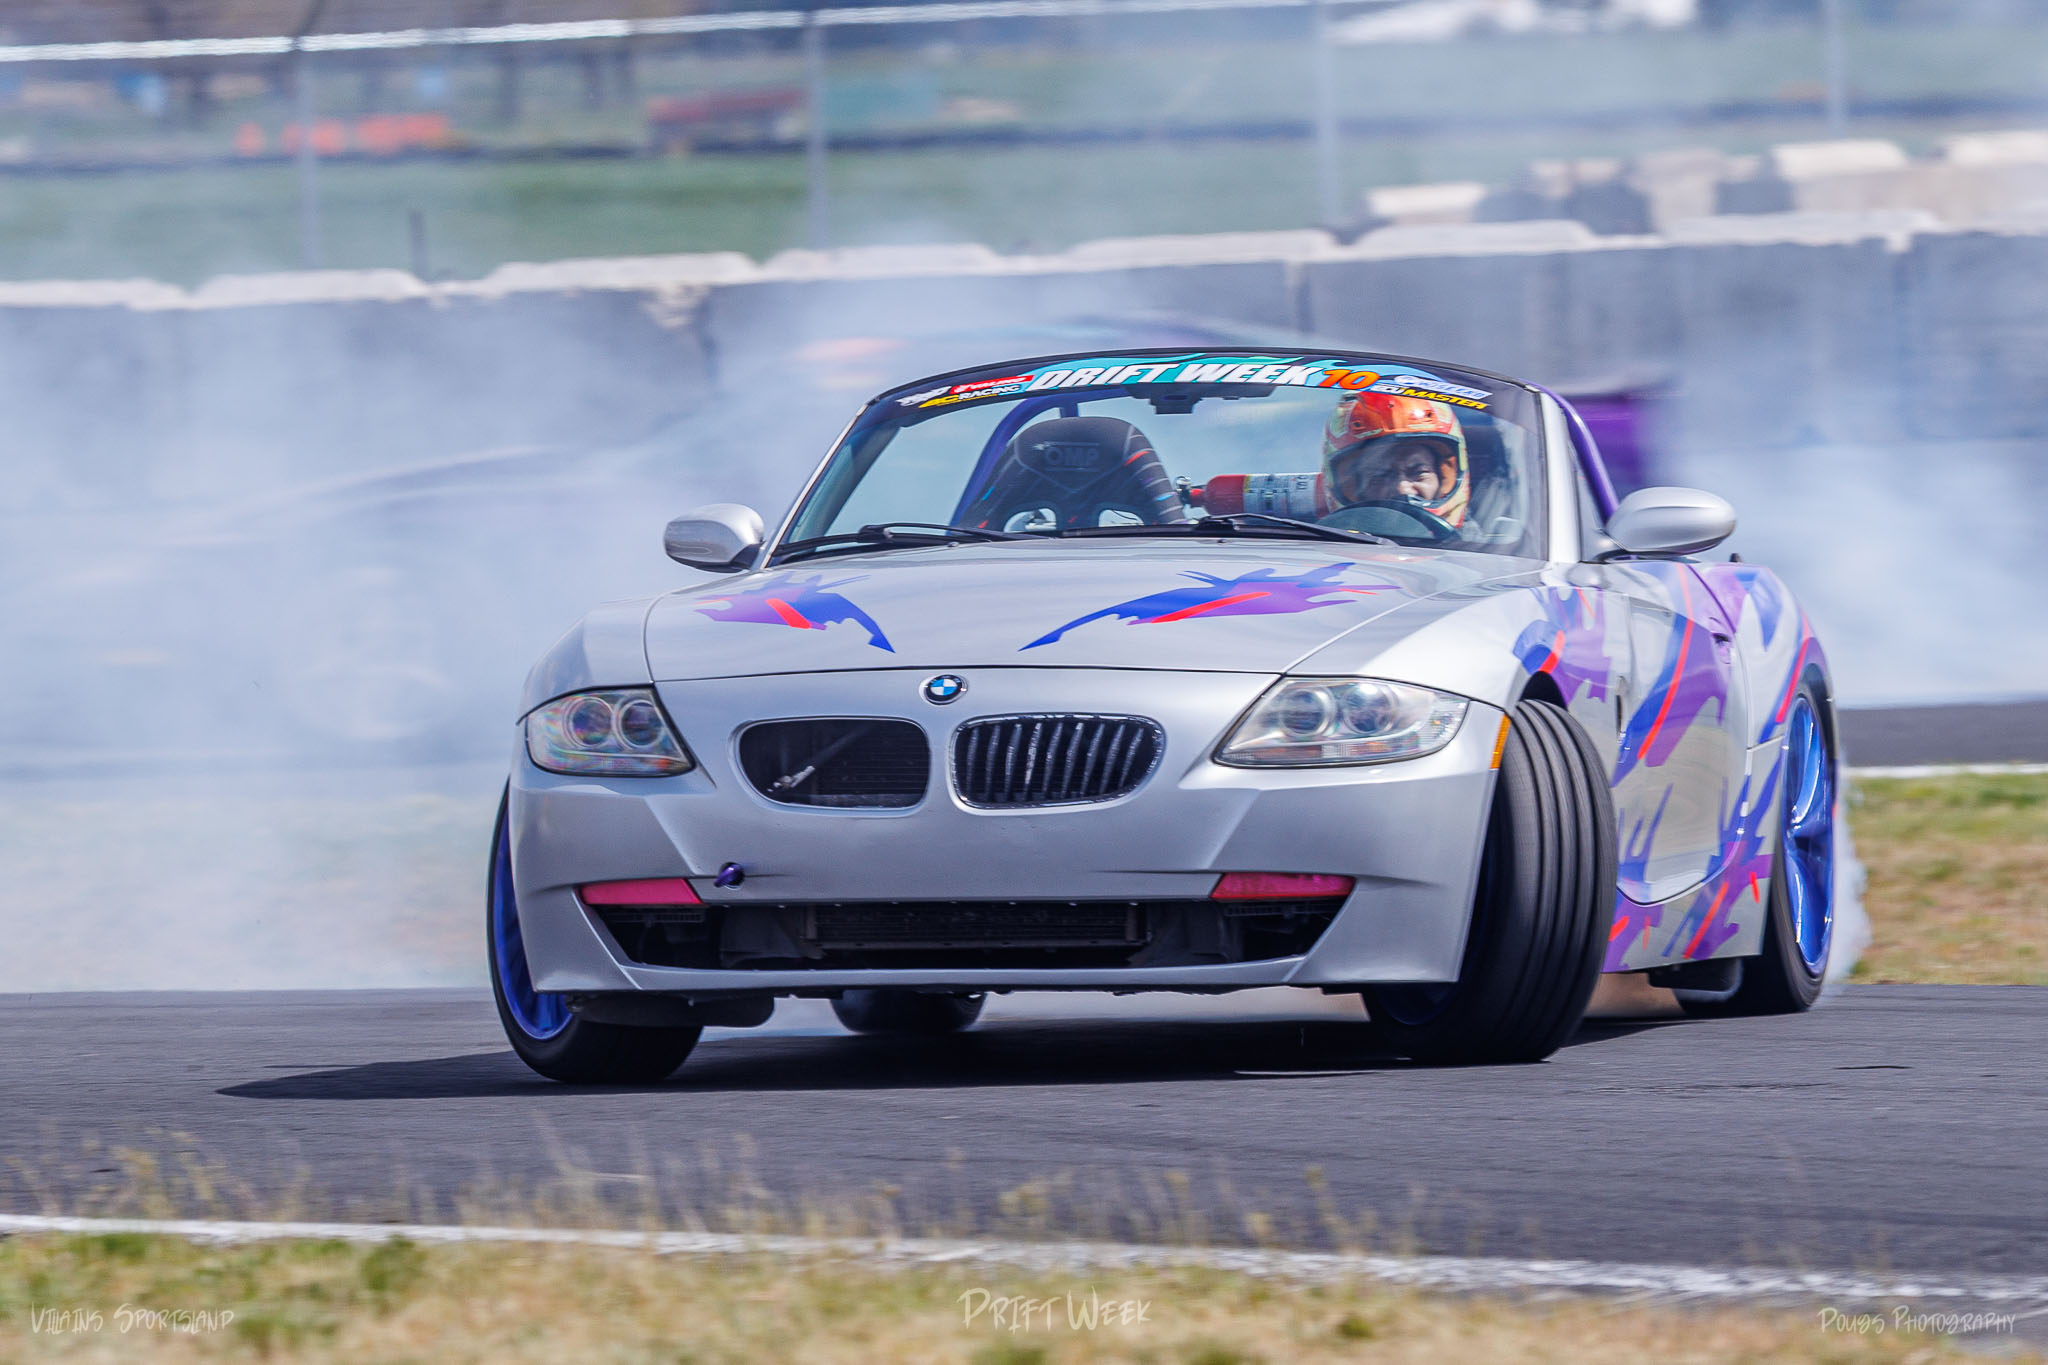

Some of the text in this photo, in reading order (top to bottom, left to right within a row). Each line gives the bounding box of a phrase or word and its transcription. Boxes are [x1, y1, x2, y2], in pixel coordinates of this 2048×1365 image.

[1025, 363, 1180, 392] DRIFT
[1174, 363, 1324, 386] WEEK
[1318, 369, 1380, 390] 10
[958, 384, 1020, 400] RACING
